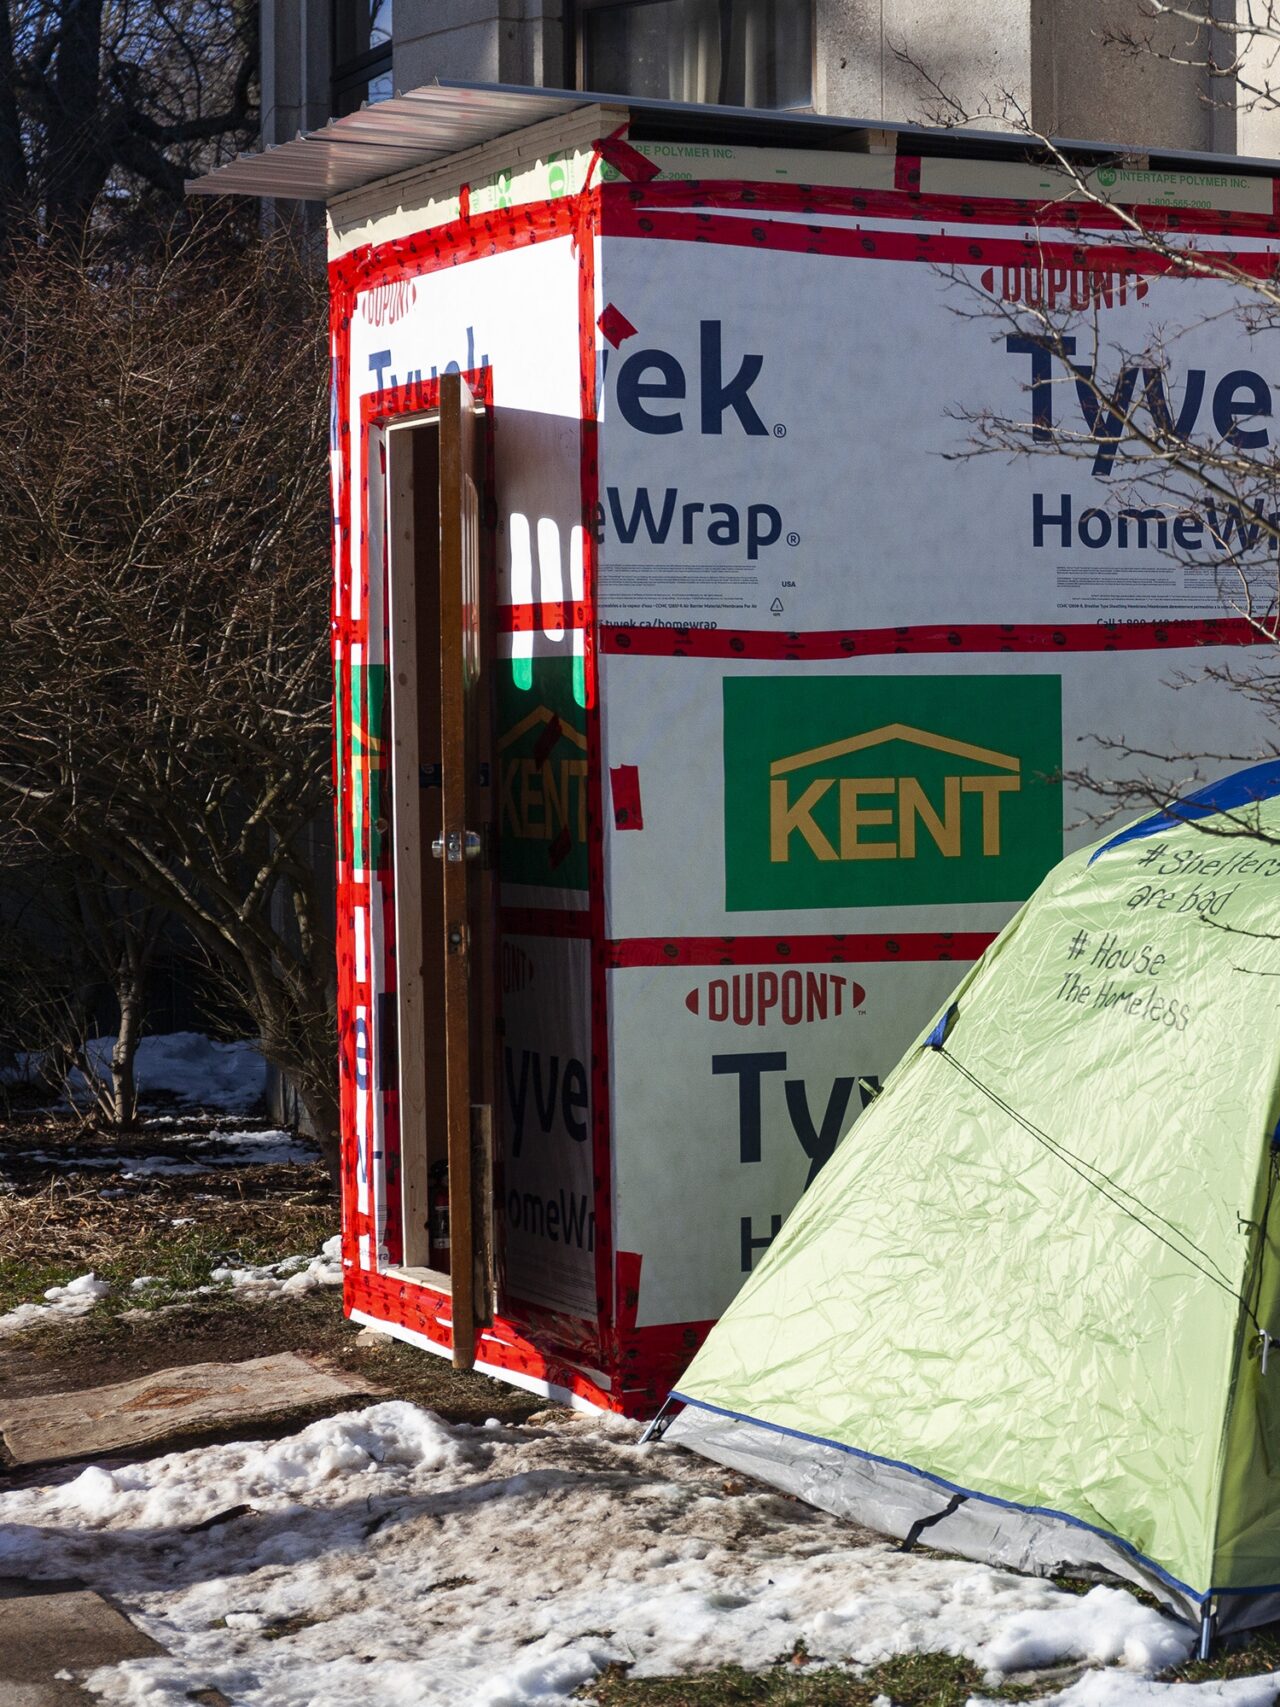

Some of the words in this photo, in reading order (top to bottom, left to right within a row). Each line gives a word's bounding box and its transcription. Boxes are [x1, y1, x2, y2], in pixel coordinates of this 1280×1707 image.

[633, 144, 651, 156] PE
[654, 145, 710, 159] POLYMER
[712, 149, 736, 160] INC.
[1120, 172, 1177, 185] INTERTAPE
[1179, 175, 1228, 188] POLYMER
[1230, 178, 1250, 190] INC.
[781, 580, 797, 588] USA
[769, 774, 1021, 863] KENT
[1126, 884, 1176, 912] are
[1176, 882, 1241, 917] bad
[708, 971, 847, 1027] DUPONT
[1056, 972, 1092, 1005] The
